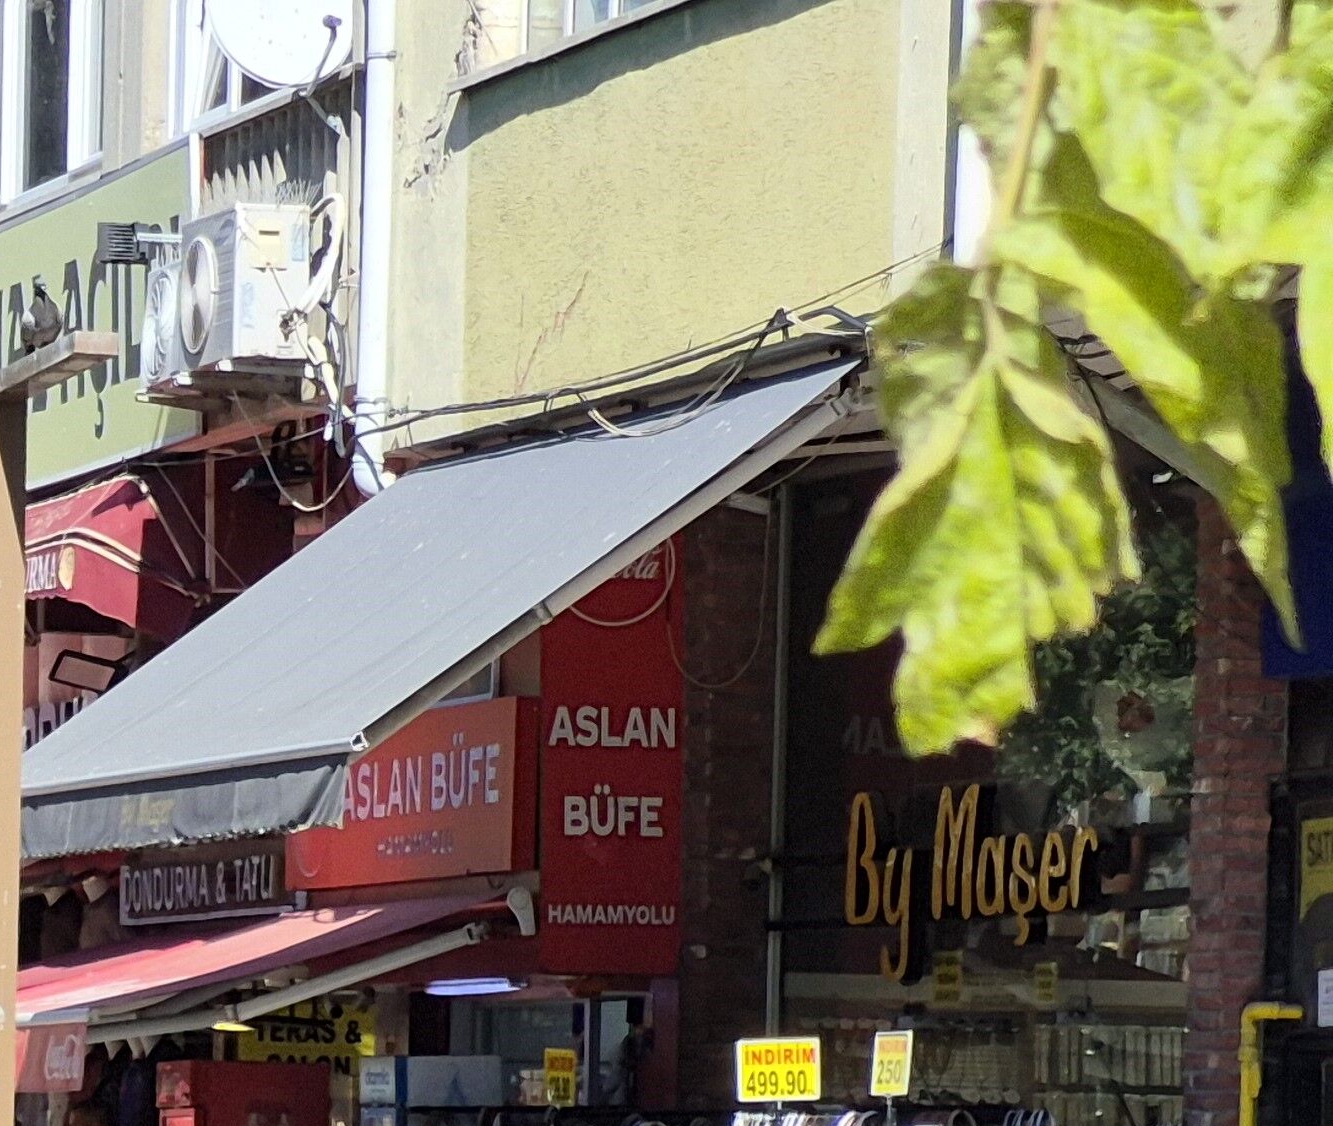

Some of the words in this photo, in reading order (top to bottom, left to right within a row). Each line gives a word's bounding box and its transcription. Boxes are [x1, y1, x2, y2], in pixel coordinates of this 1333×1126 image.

[549, 705, 676, 748] ASLAN
[431, 732, 500, 811] BÜFE
[564, 783, 664, 838] BÜFE
[120, 864, 209, 913] DONDURMA
[215, 861, 226, 904] &
[845, 792, 912, 983] By
[932, 783, 1098, 946] Maşer
[548, 904, 676, 926] HAMAMYOLU
[744, 1045, 816, 1066] İNDİRİM
[877, 1059, 902, 1085] 250
[746, 1069, 808, 1097] 499.90
